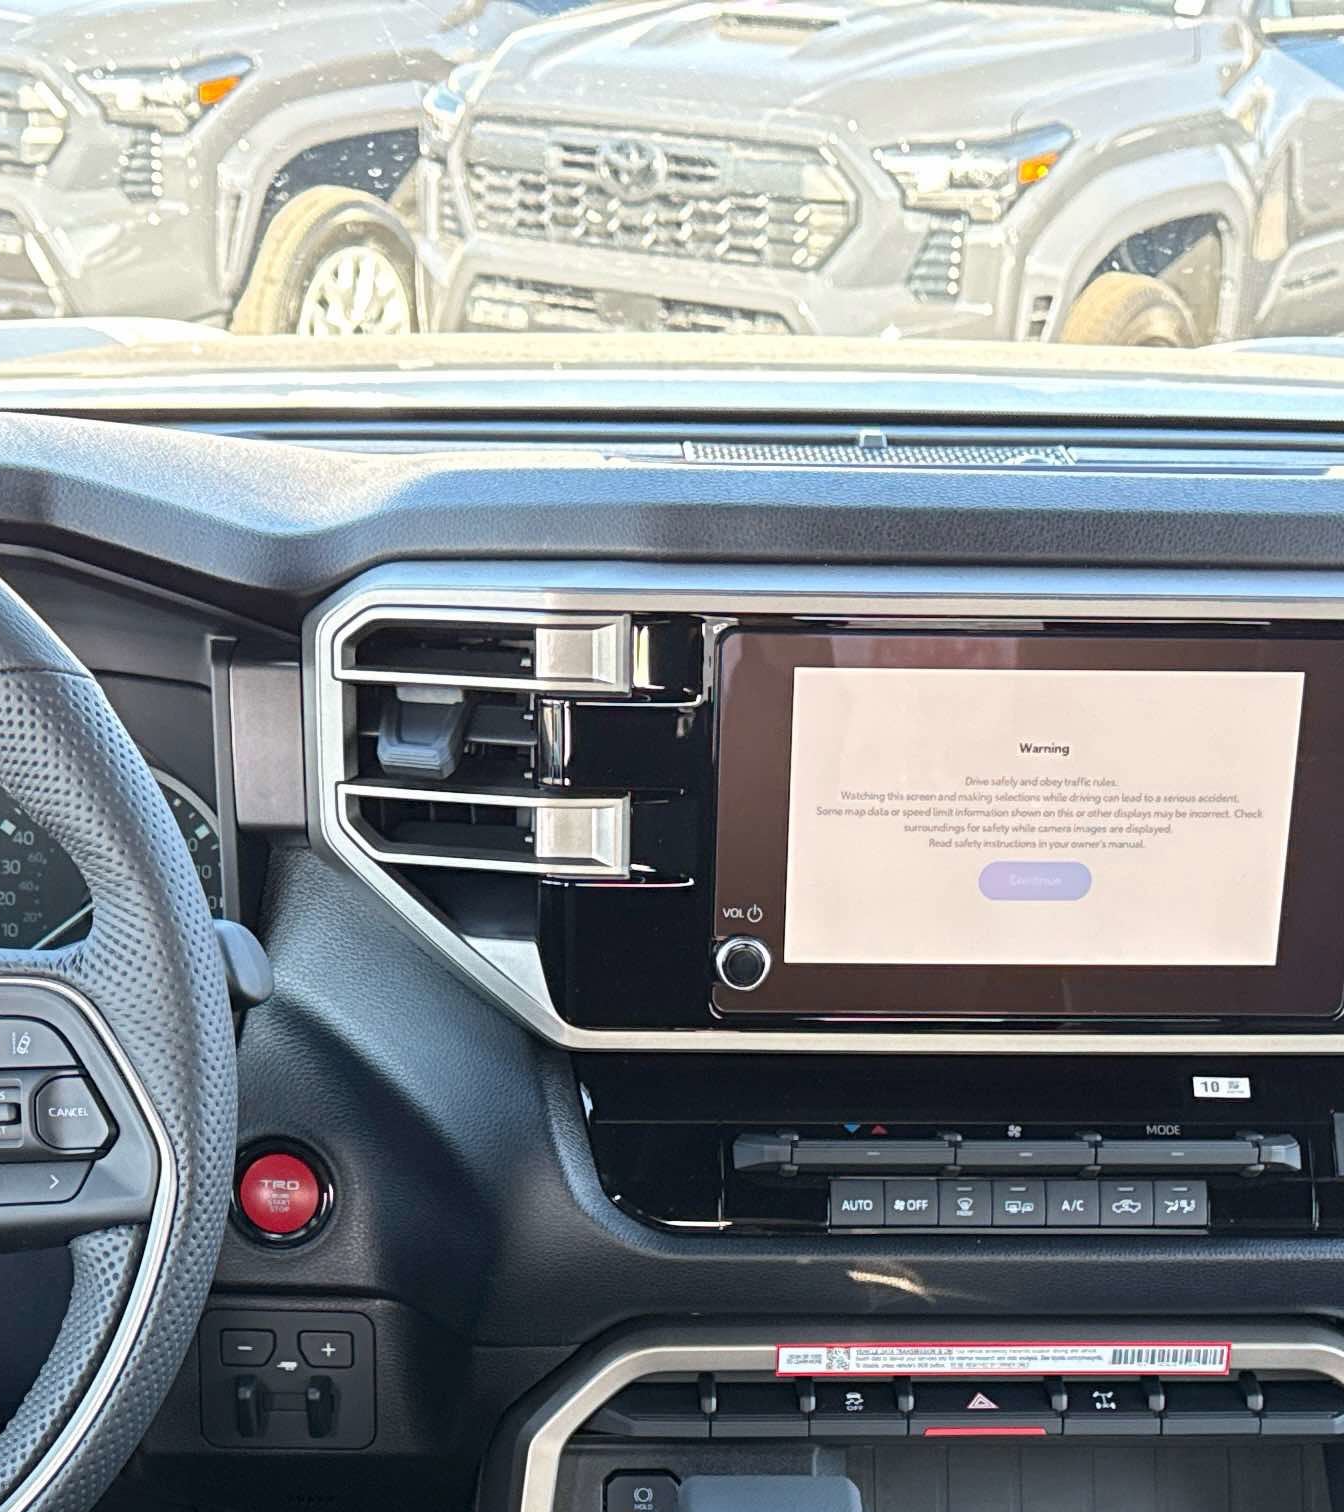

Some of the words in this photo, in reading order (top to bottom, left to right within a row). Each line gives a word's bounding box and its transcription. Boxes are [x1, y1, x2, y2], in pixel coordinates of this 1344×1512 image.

[1019, 742, 1070, 756] Warning
[965, 777, 988, 787] Drive
[991, 777, 1017, 789] safely
[1020, 777, 1036, 787] and
[1040, 777, 1062, 789] obey
[1064, 778, 1091, 788] traffic
[1093, 778, 1119, 788] rules.
[841, 791, 885, 803] Watching
[887, 791, 904, 801] this
[906, 793, 936, 801] screen
[938, 791, 956, 801] and
[958, 791, 992, 803] making
[1043, 792, 1067, 802] while
[1069, 793, 1101, 805] driving
[1103, 795, 1120, 803] can
[1122, 793, 1142, 803] lead
[1144, 794, 1154, 803] to
[1163, 794, 1196, 803] serious
[816, 806, 843, 816] Some
[845, 808, 865, 818] map
[868, 807, 889, 817] data
[891, 809, 900, 817] or
[902, 807, 930, 819] speed
[933, 807, 953, 817] limit
[1011, 808, 1040, 818] shown
[1043, 810, 1055, 818] on
[1057, 808, 1074, 818] this
[1076, 810, 1085, 818] or
[1087, 808, 1112, 818] other
[1114, 808, 1151, 820] displays
[1154, 811, 1173, 820] may
[1175, 809, 1187, 818] be
[1234, 809, 1263, 819] Check
[967, 823, 980, 833] for
[982, 823, 1009, 835] safety
[1011, 823, 1035, 833] while
[1038, 825, 1071, 834] camera
[1073, 824, 1106, 836] images
[1109, 826, 1123, 834] are
[12, 831, 35, 845] 40
[929, 838, 952, 848] Read
[954, 838, 982, 850] safety
[1038, 839, 1047, 849] in
[1049, 841, 1069, 851] your
[1071, 839, 1106, 849] owner's
[1108, 839, 1145, 849] manual.
[1, 860, 21, 874] 30
[723, 908, 745, 920] VOL
[2, 923, 19, 937] 10
[48, 1107, 89, 1118] CANCEL
[1146, 1125, 1181, 1136] MODE
[259, 1179, 300, 1191] TRD
[841, 1199, 873, 1211] AUTO
[907, 1199, 929, 1211] OFF
[1061, 1199, 1085, 1212] A/C
